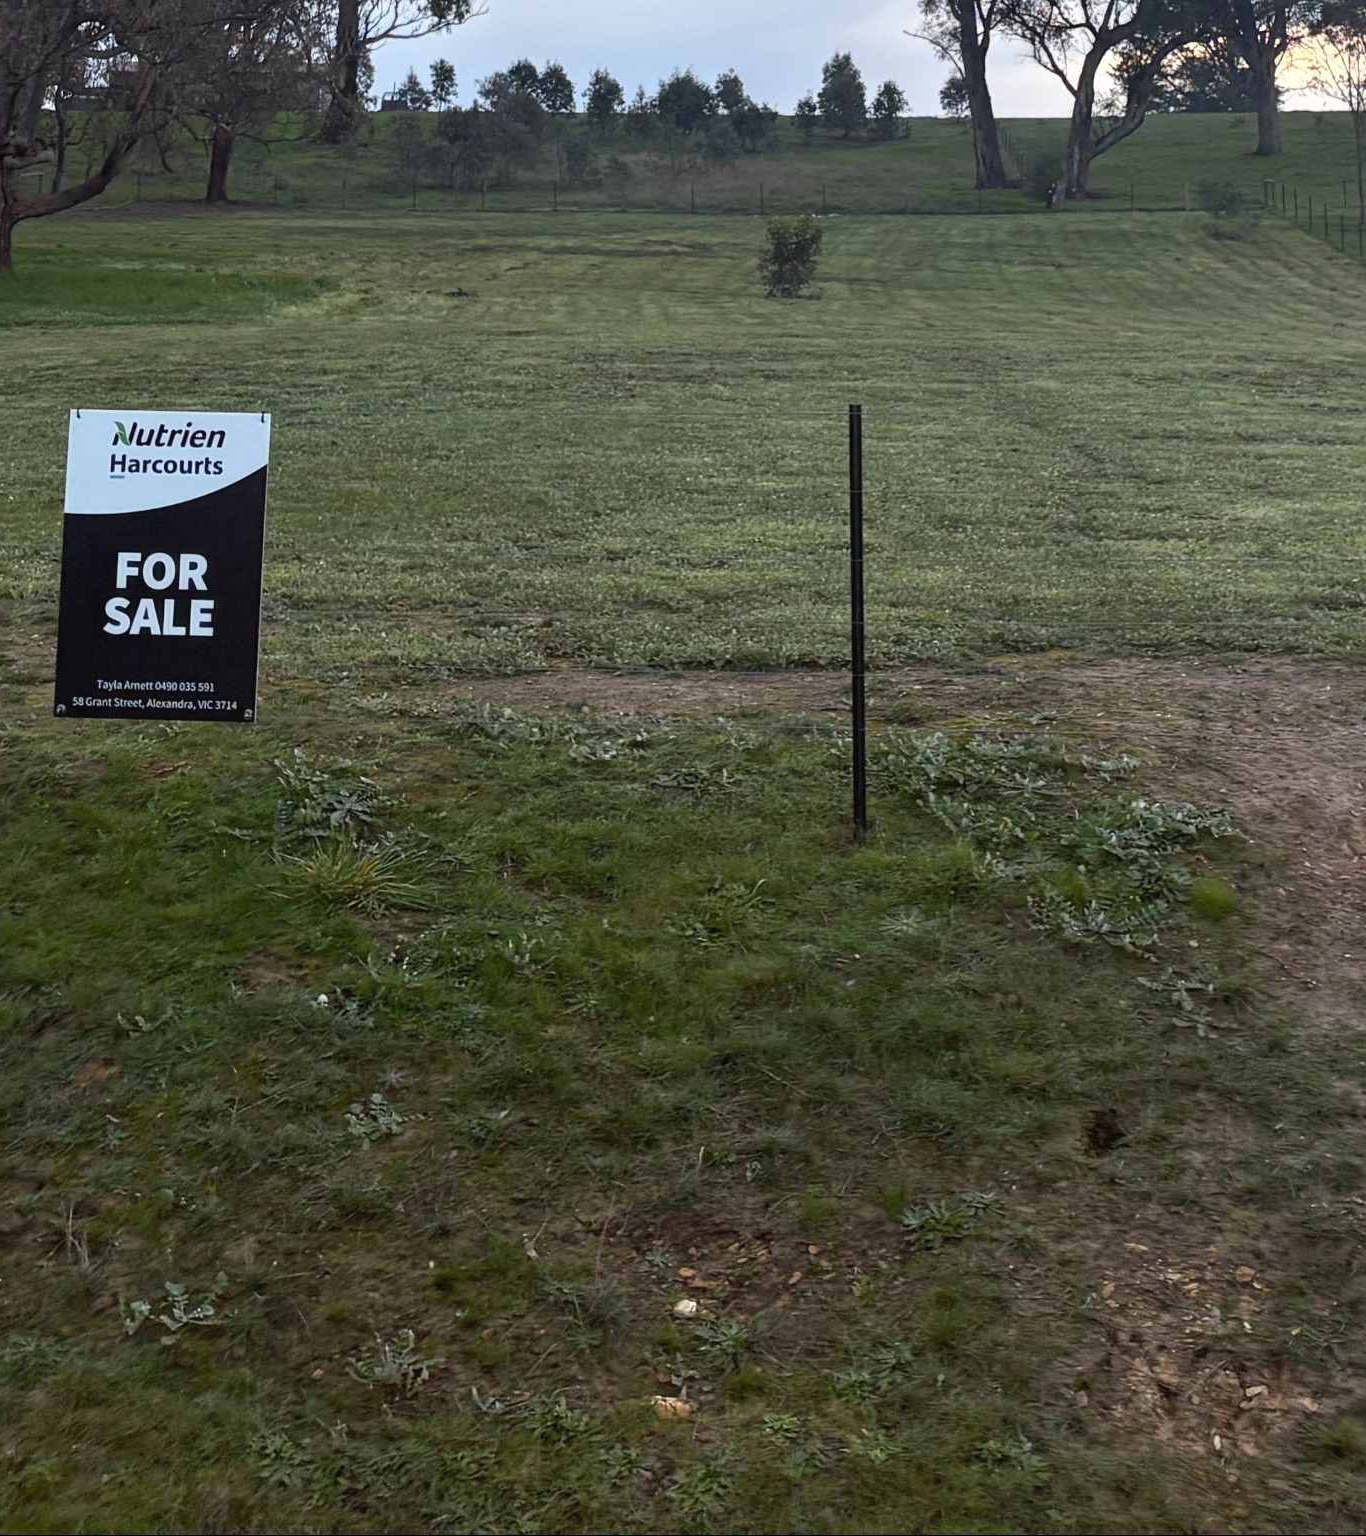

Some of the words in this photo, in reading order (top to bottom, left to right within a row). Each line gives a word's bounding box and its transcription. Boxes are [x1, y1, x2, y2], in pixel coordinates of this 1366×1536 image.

[112, 421, 226, 448] Nutrien
[110, 454, 223, 475] Harcourts
[116, 552, 208, 591] FOR
[103, 597, 215, 637] SALE
[97, 679, 122, 691] Tayla
[155, 681, 178, 691] 0490
[179, 682, 197, 692] 035
[198, 682, 215, 692] 591
[72, 696, 84, 706] 58
[85, 697, 112, 707] Grant
[114, 698, 145, 709] Street,
[146, 698, 196, 710] Alexandra,
[198, 700, 213, 709] VIC
[215, 700, 238, 710] 3714
